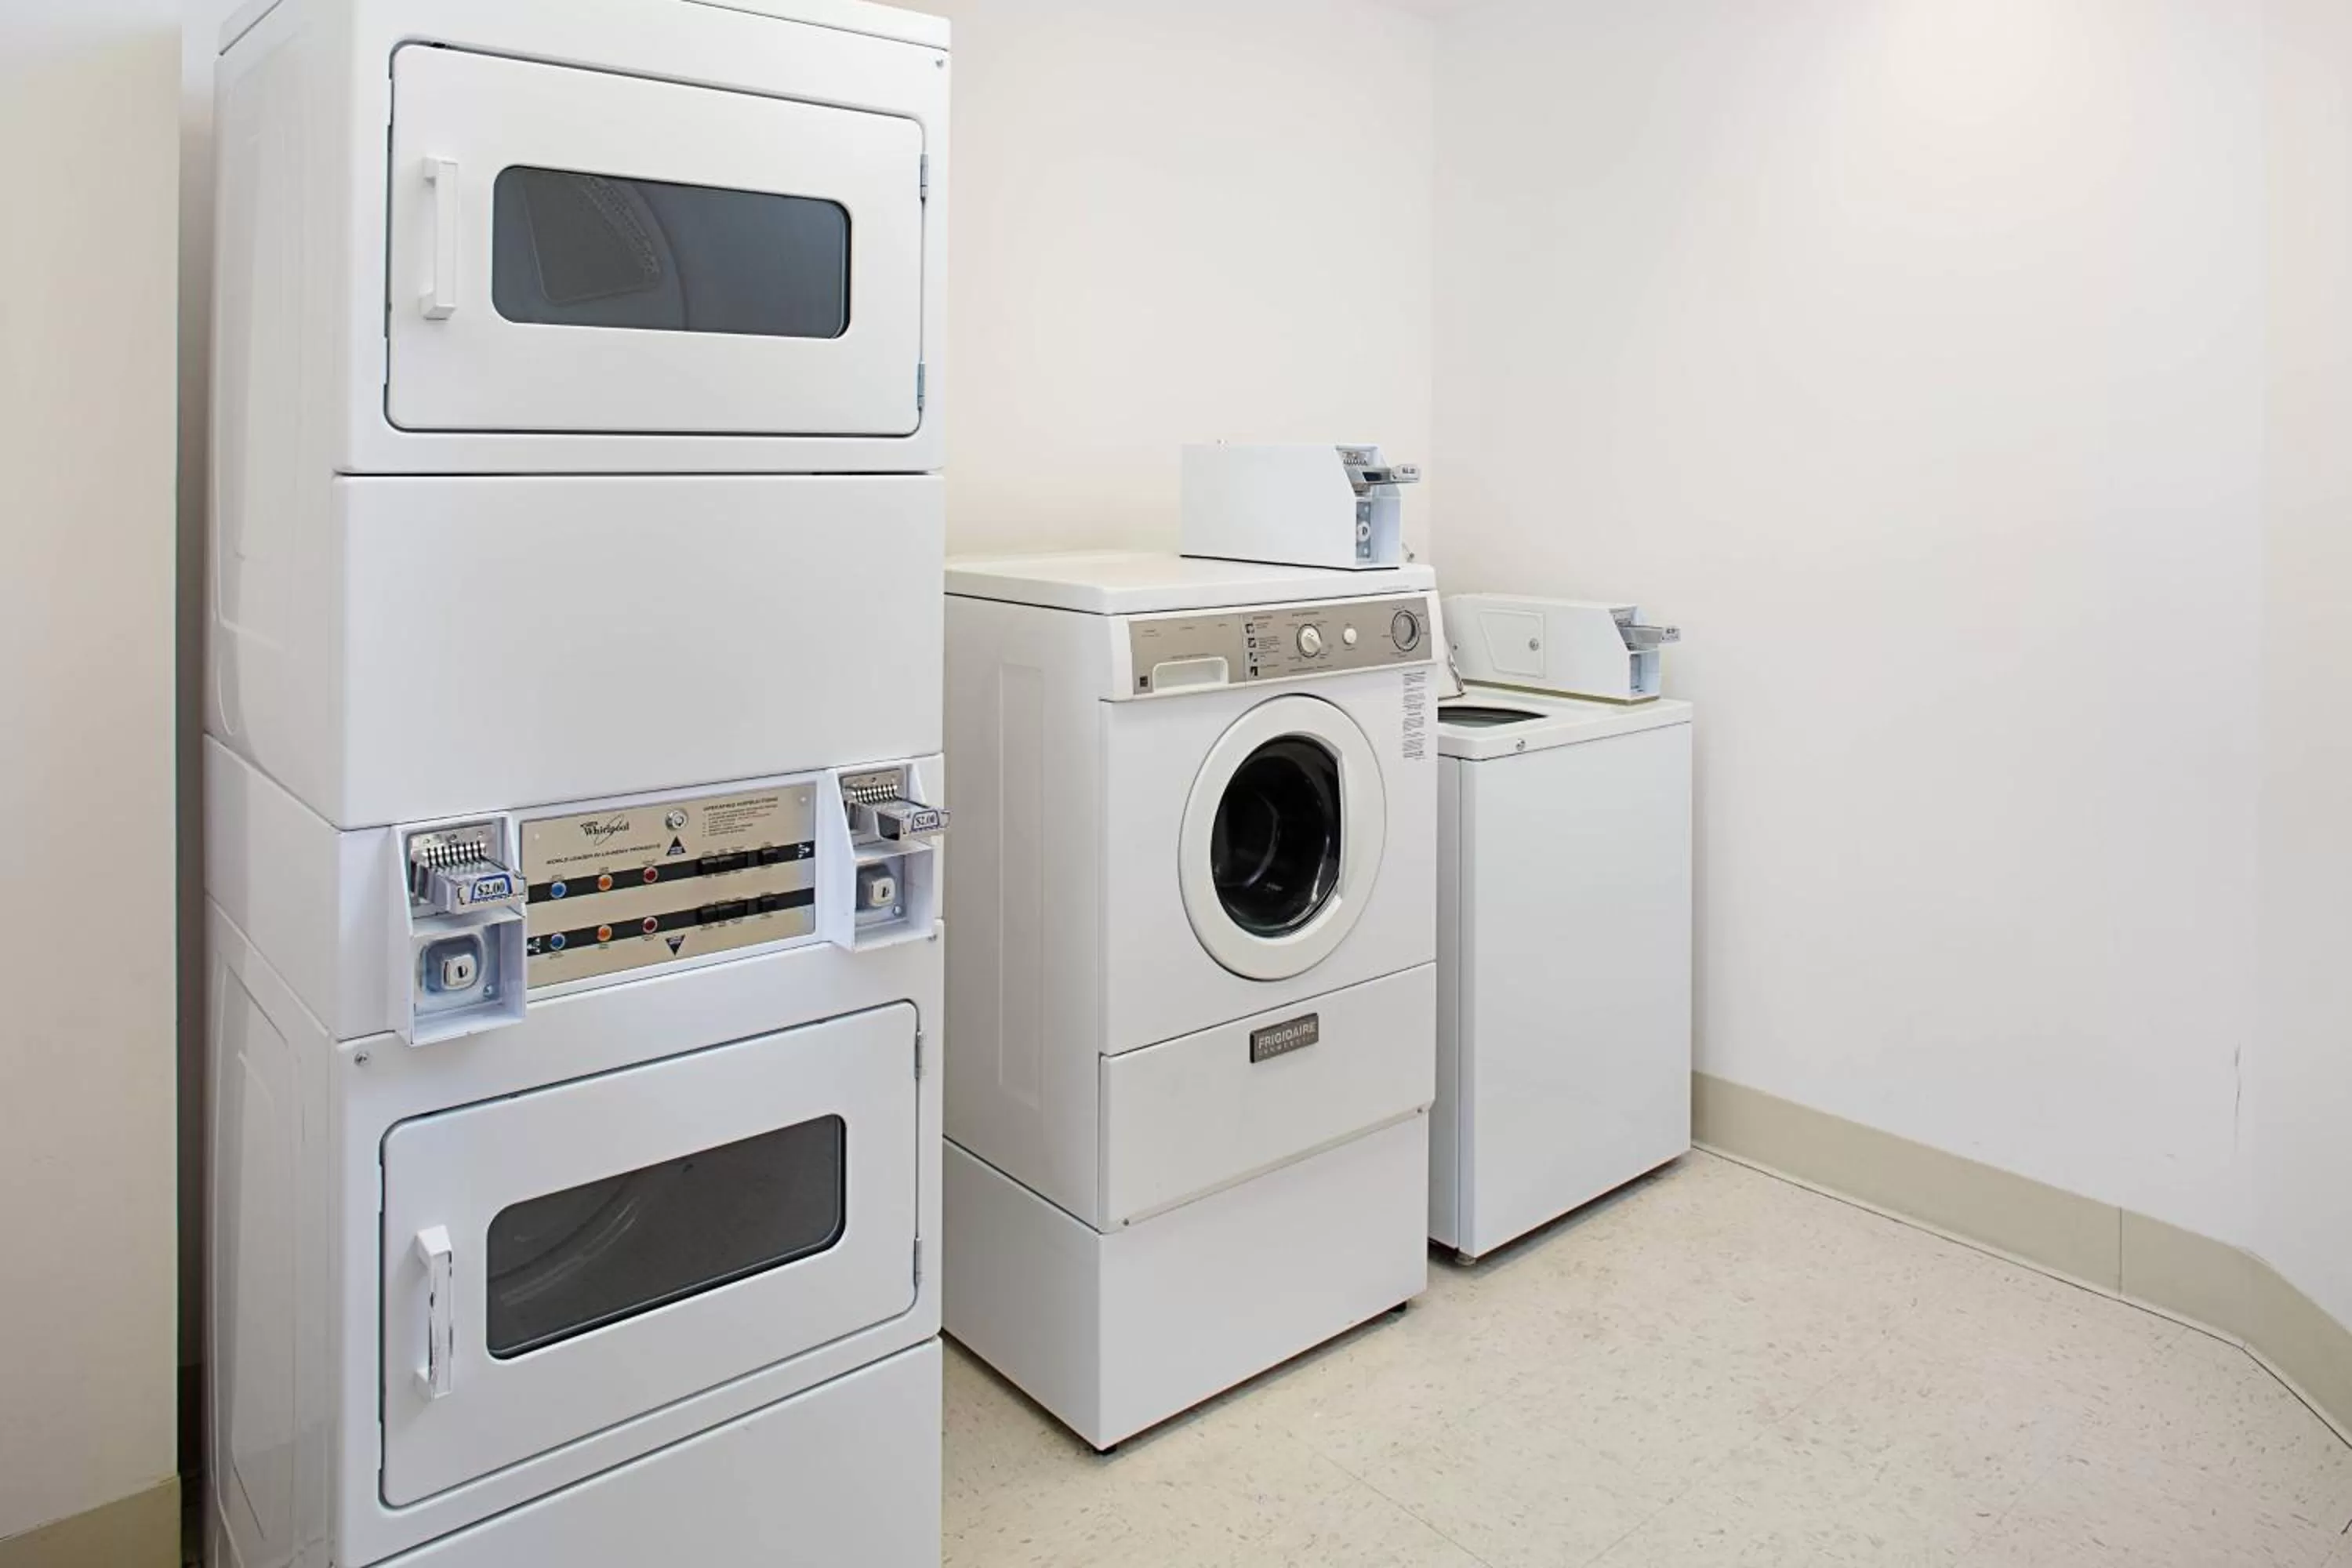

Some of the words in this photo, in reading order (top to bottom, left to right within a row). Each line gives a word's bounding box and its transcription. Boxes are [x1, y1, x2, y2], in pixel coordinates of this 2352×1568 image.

[580, 821, 630, 836] Whirlpool
[477, 880, 506, 895] $2.00
[1258, 1022, 1316, 1049] FRIGIDAIRE
